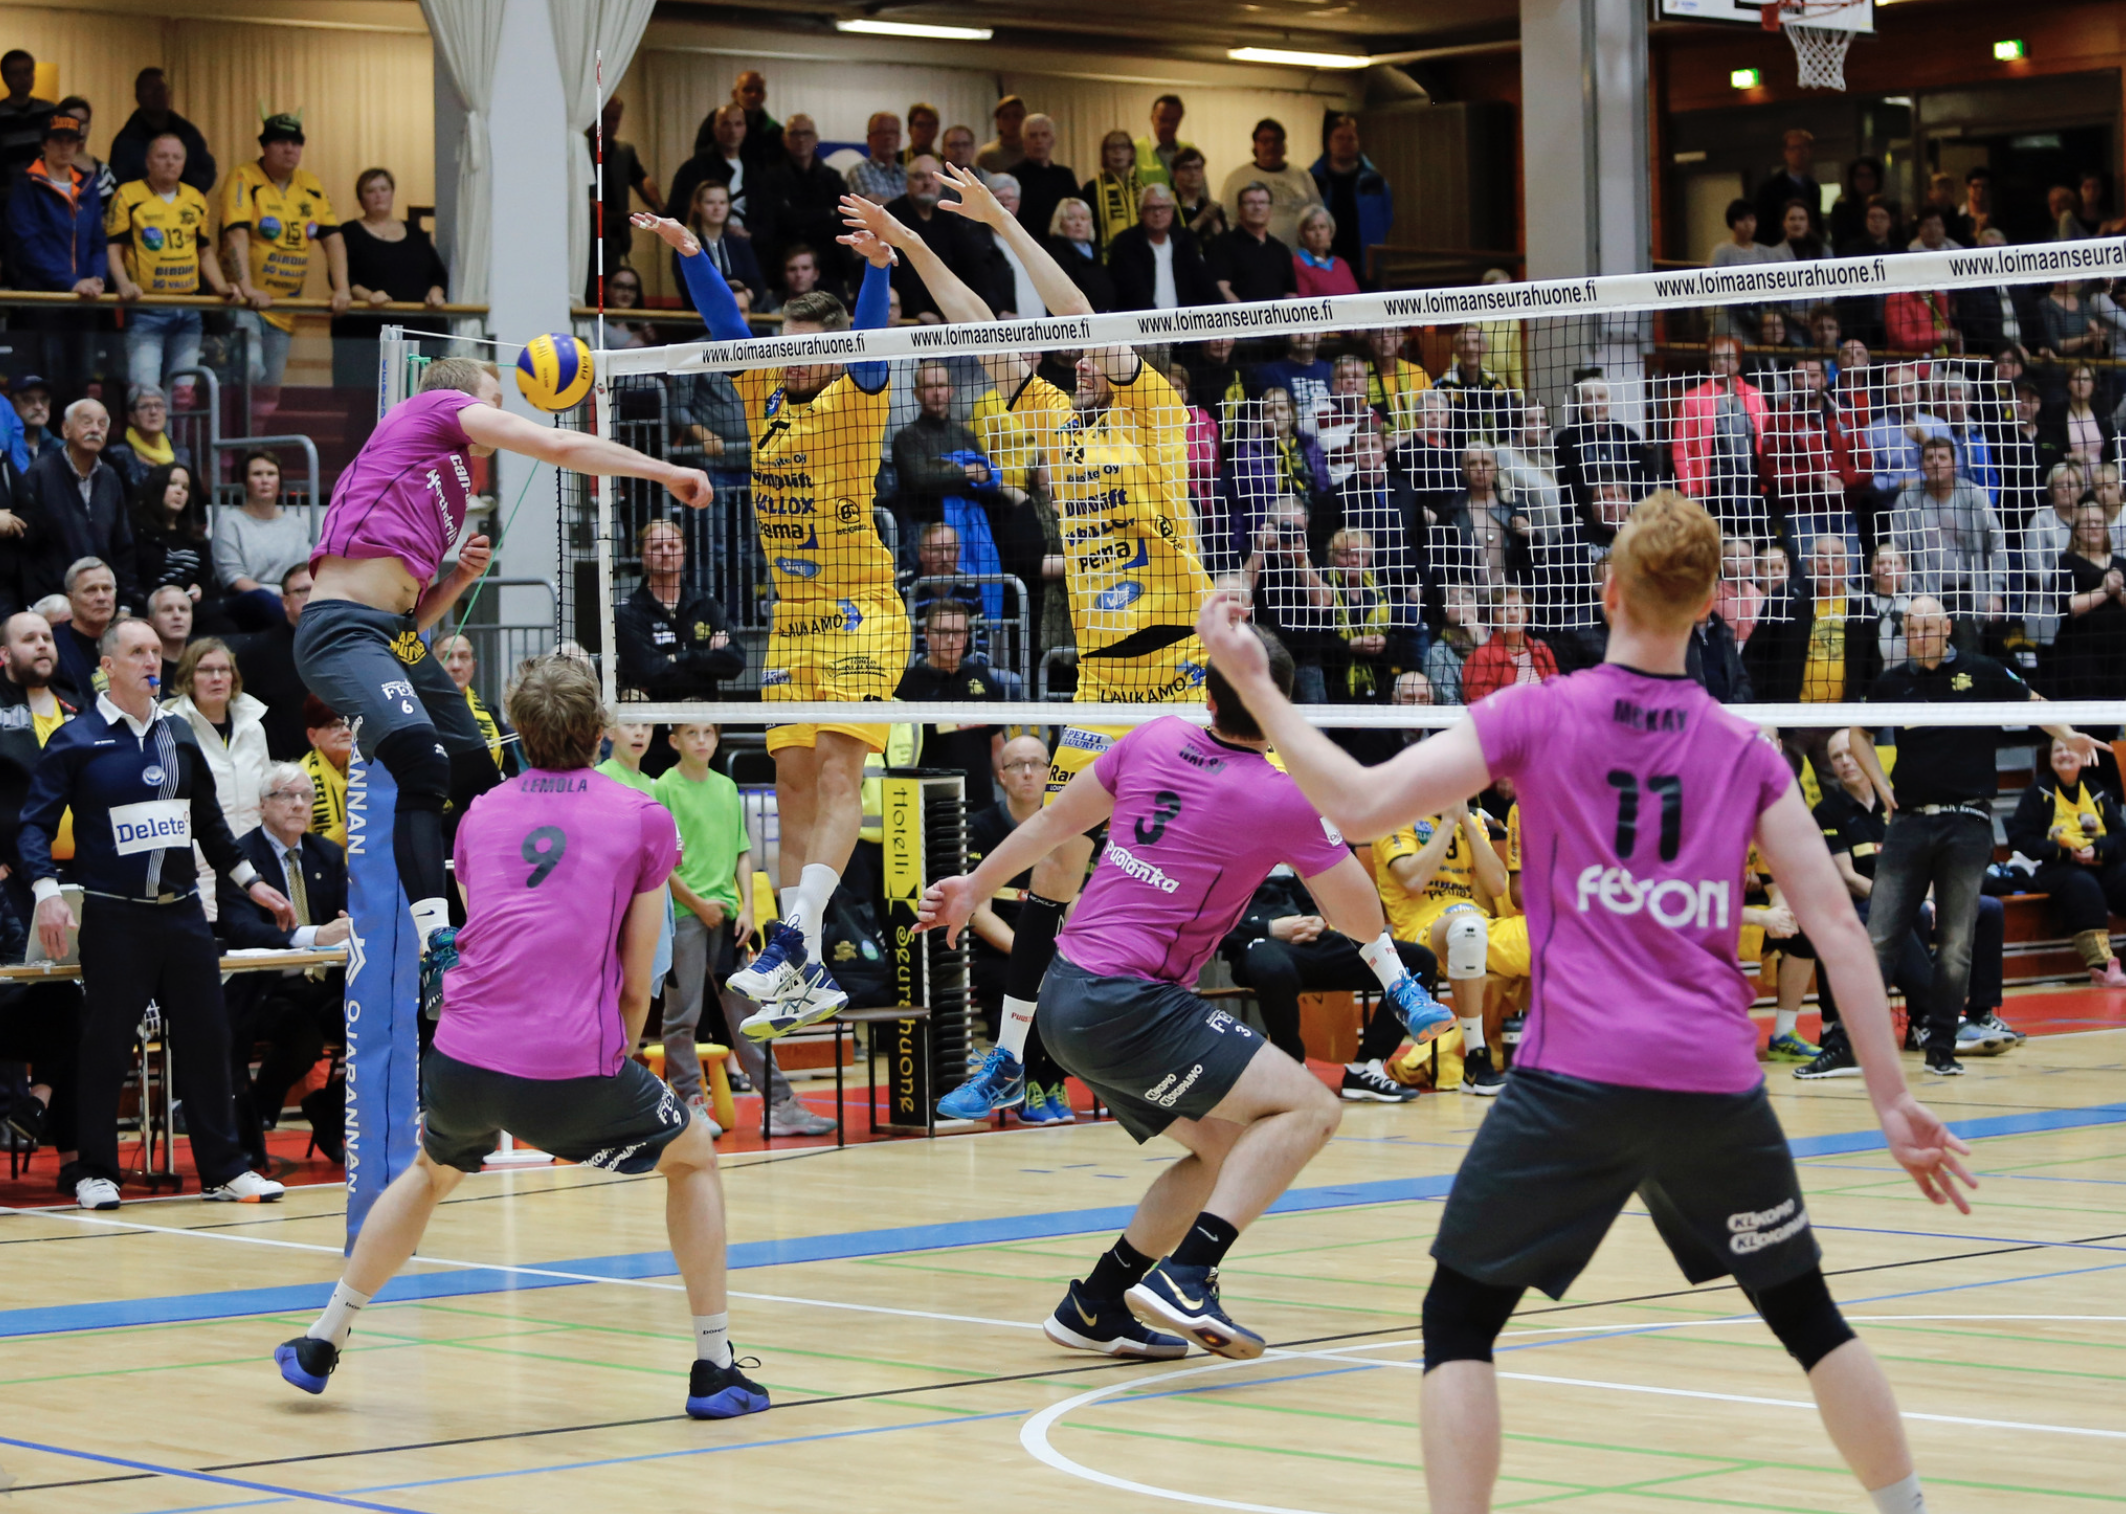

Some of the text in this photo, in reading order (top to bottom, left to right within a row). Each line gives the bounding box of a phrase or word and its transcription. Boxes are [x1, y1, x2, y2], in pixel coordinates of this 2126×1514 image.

[166, 228, 184, 250] 13
[1948, 240, 2126, 277] www.loimaanseura
[1654, 260, 1887, 298] www.loimaanseurahuone.fi
[1383, 279, 1598, 316] www.loimaanseurahuone.fi
[910, 318, 1091, 347] www.loimaanseurahuone.fi
[1137, 299, 1334, 334] www.loimaanseurahuone.fi
[702, 332, 866, 364] www.loimaanseurahuone.fi
[793, 454, 807, 464] Oy
[1103, 464, 1119, 475] Oy
[401, 699, 415, 714] 6
[521, 777, 588, 794] LEMOLA
[116, 816, 186, 844] Delete
[892, 787, 909, 876] Hotelli
[1133, 790, 1182, 846] 3
[1606, 768, 1683, 863] 11
[520, 825, 567, 889] 9
[895, 925, 917, 1114] Seurhuone
[1234, 1025, 1252, 1038] 3
[345, 1000, 362, 1193] OJARANNAN
[672, 1110, 682, 1126] 9
